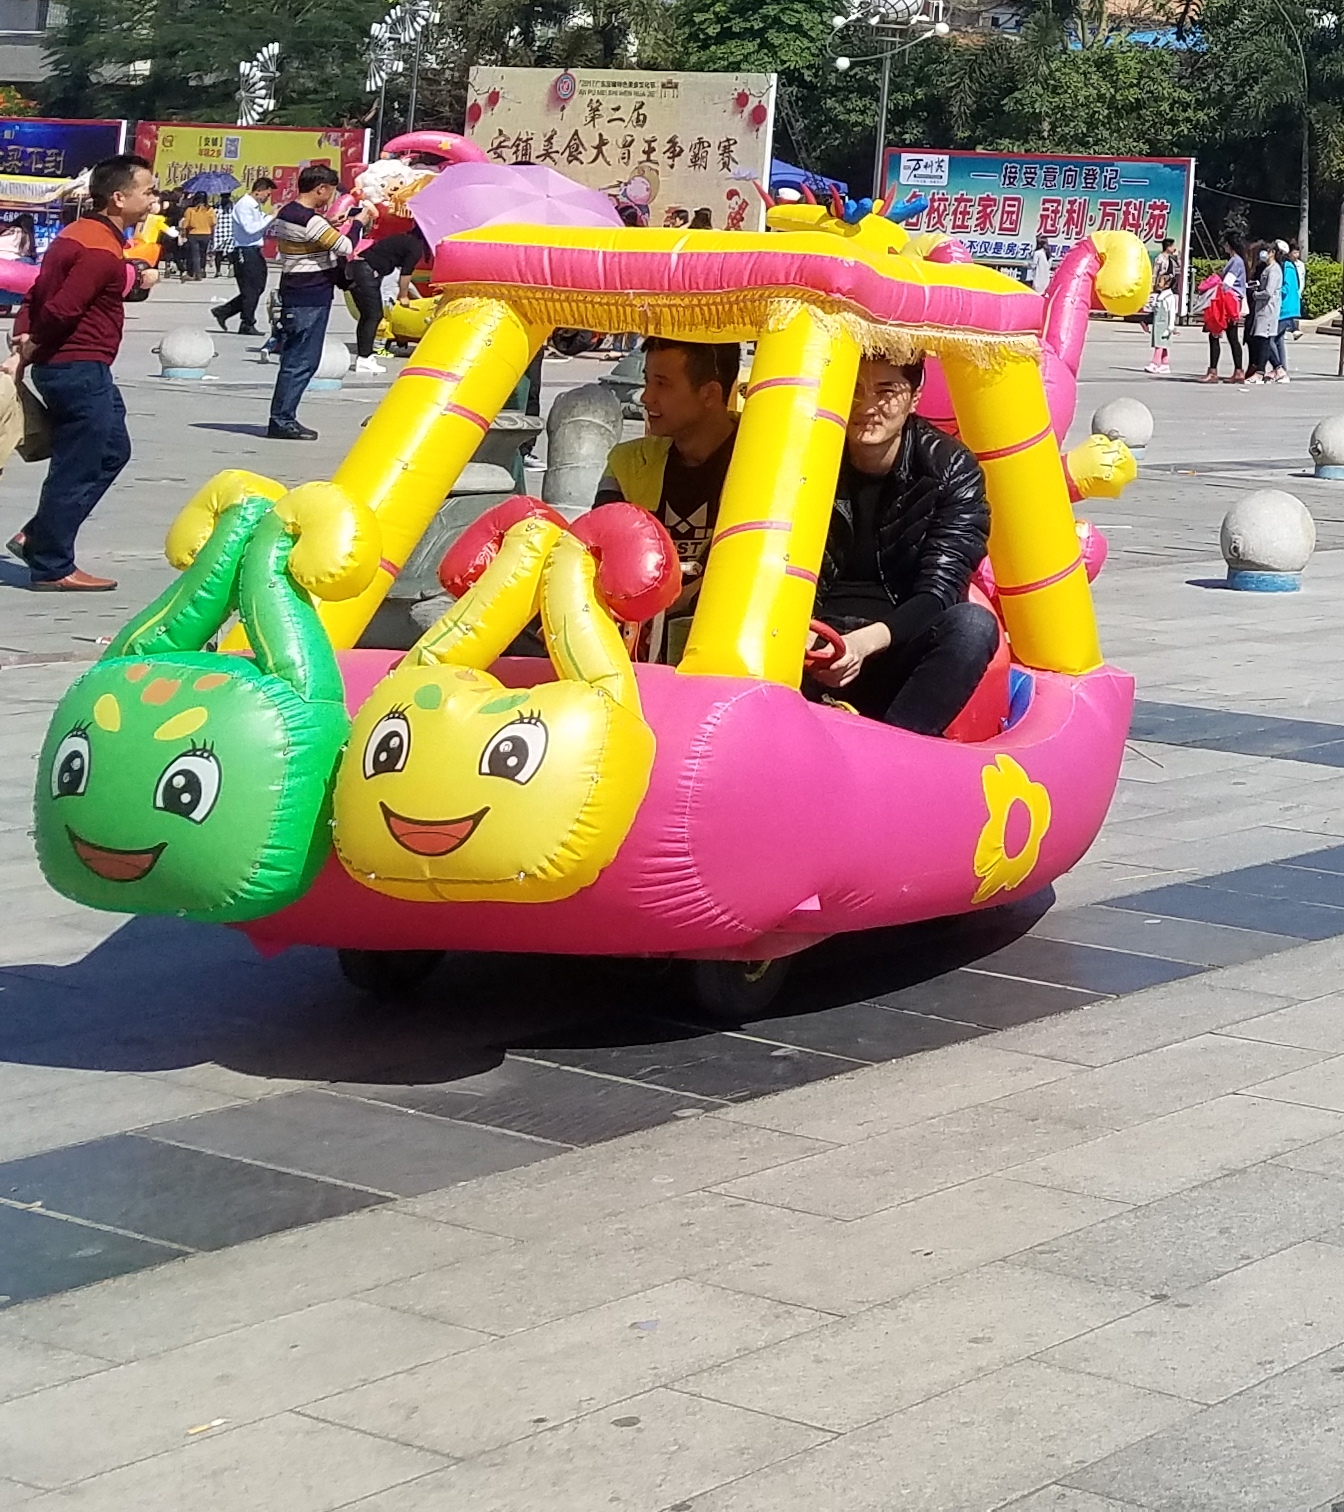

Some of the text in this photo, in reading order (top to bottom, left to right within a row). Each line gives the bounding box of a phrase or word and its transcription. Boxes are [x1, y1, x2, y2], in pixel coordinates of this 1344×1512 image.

[583, 98, 648, 129] 第二届
[1001, 163, 1121, 191] 接受意向登记
